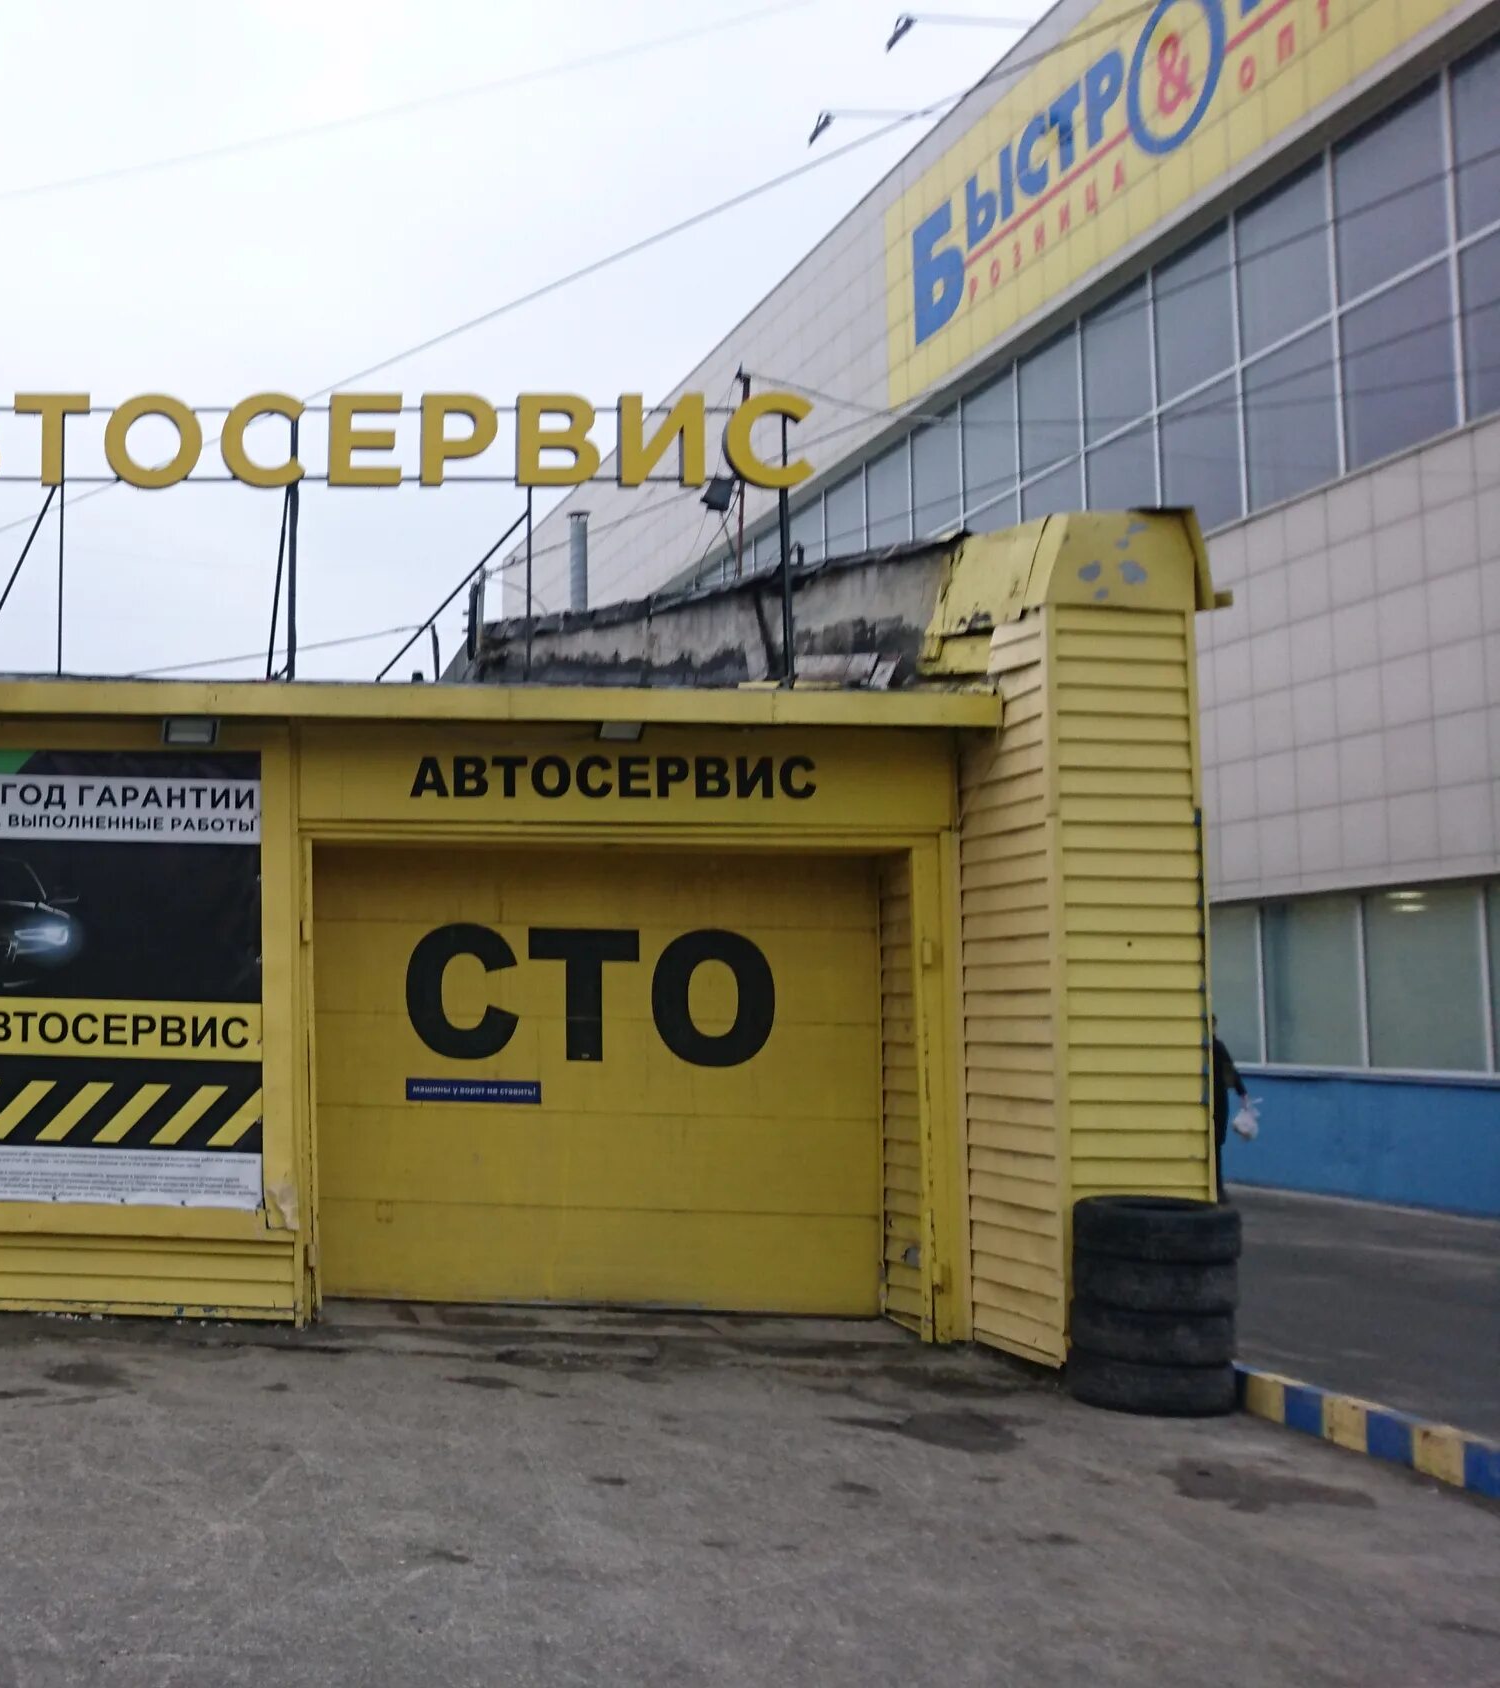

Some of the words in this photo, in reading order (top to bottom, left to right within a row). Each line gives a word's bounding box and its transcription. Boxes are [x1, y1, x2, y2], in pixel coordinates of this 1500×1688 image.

[969, 159, 1126, 303] РОЗНИЦА
[1, 783, 66, 810] ГОД
[78, 785, 254, 809] ГАРАНТИИ
[410, 755, 816, 799] АВТОСЕРВИС
[8, 814, 163, 831] ВЫПОЛНЕННЫЕ
[171, 817, 255, 833] РАБОТЫ
[406, 923, 775, 1067] СТО
